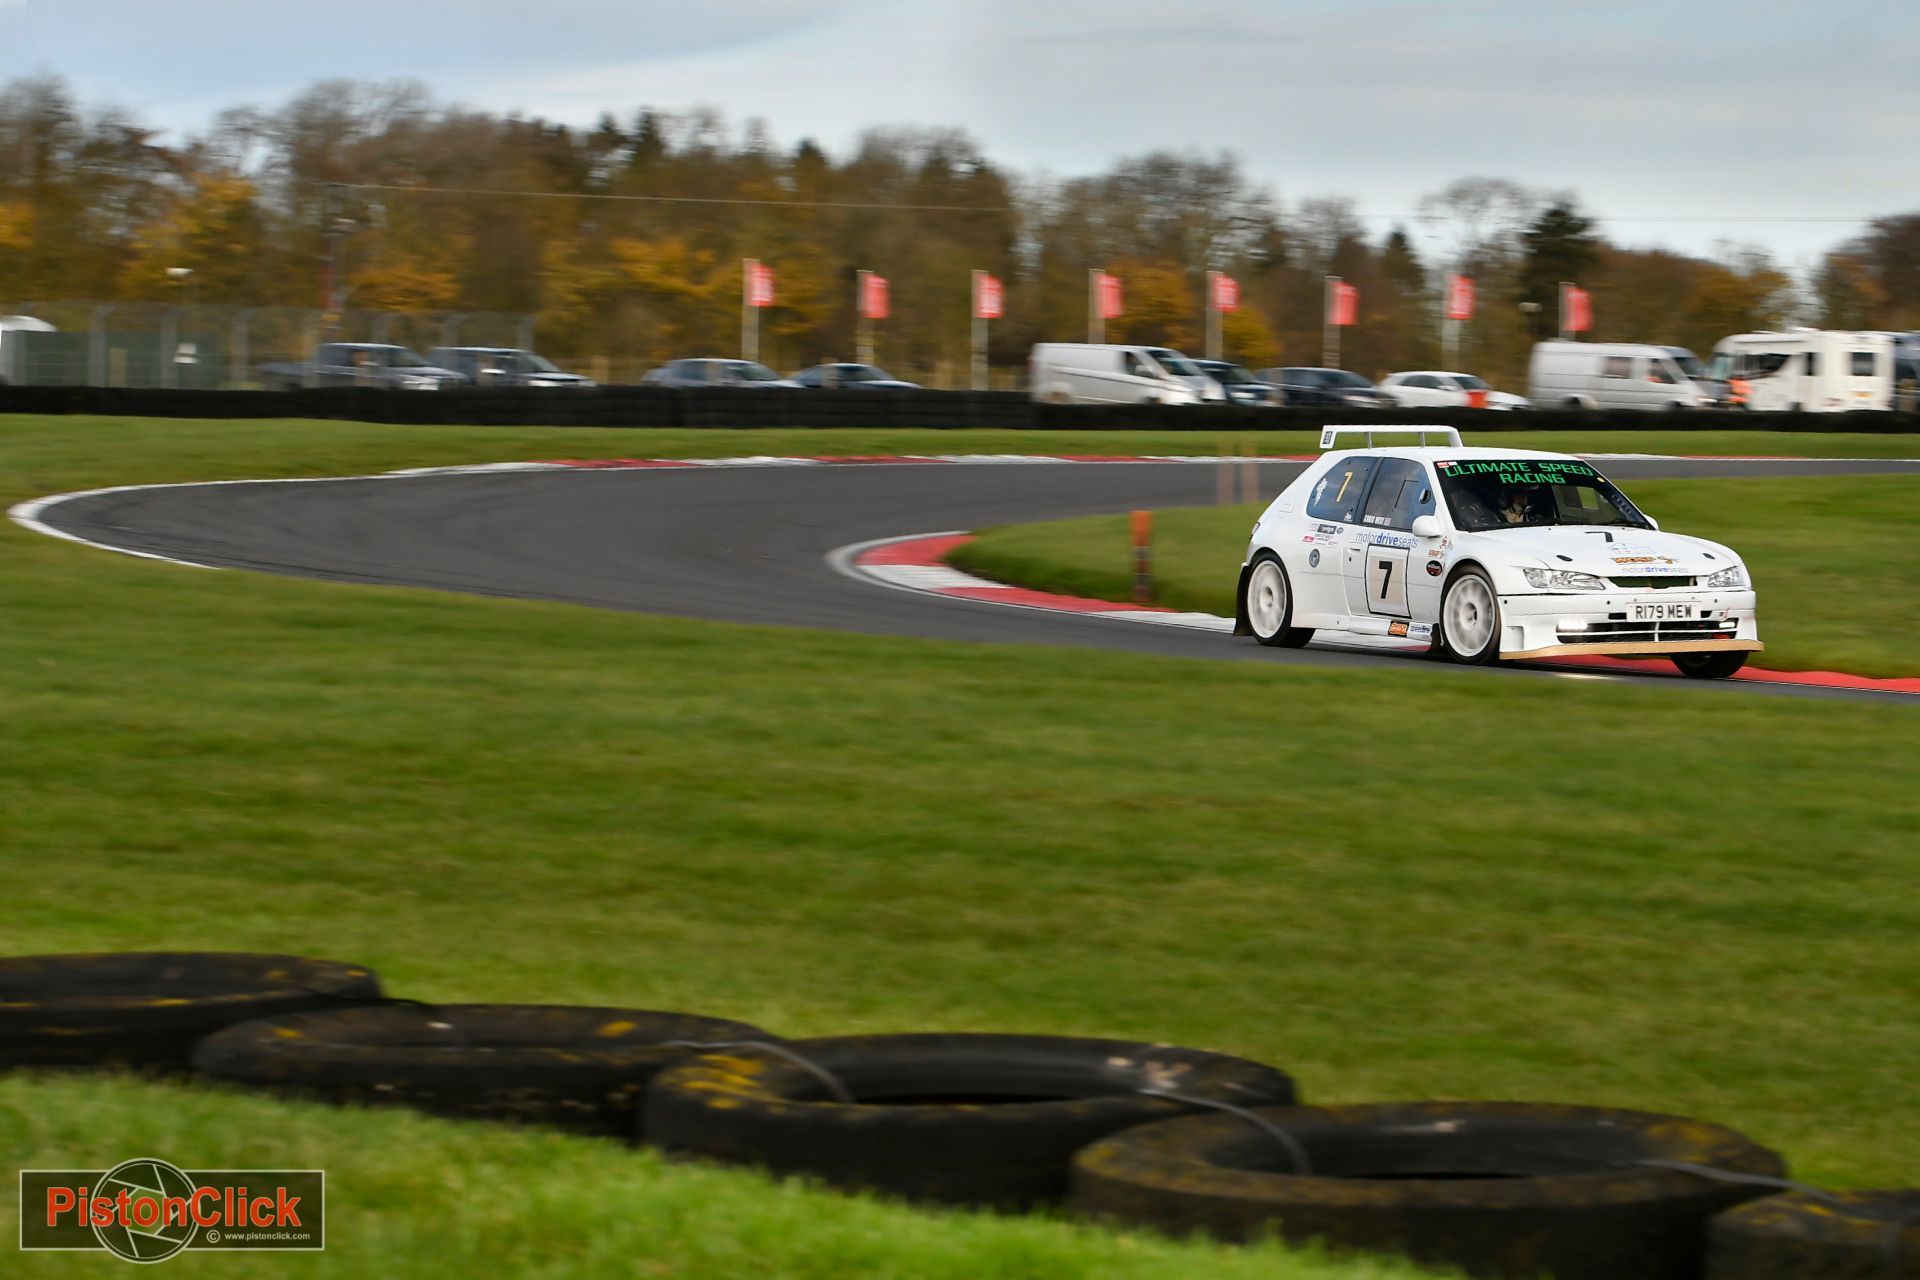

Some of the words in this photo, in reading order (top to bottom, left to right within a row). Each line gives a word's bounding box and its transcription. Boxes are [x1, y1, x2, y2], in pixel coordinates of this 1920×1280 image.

[1445, 462, 1531, 477] ULTIMATE
[1539, 462, 1593, 476] SPEED
[1336, 471, 1353, 502] 7
[1500, 473, 1566, 484] RACING
[1355, 532, 1419, 549] motordriveseats
[1379, 561, 1393, 599] 7
[1635, 604, 1664, 620] R179
[1668, 604, 1692, 619] MEW
